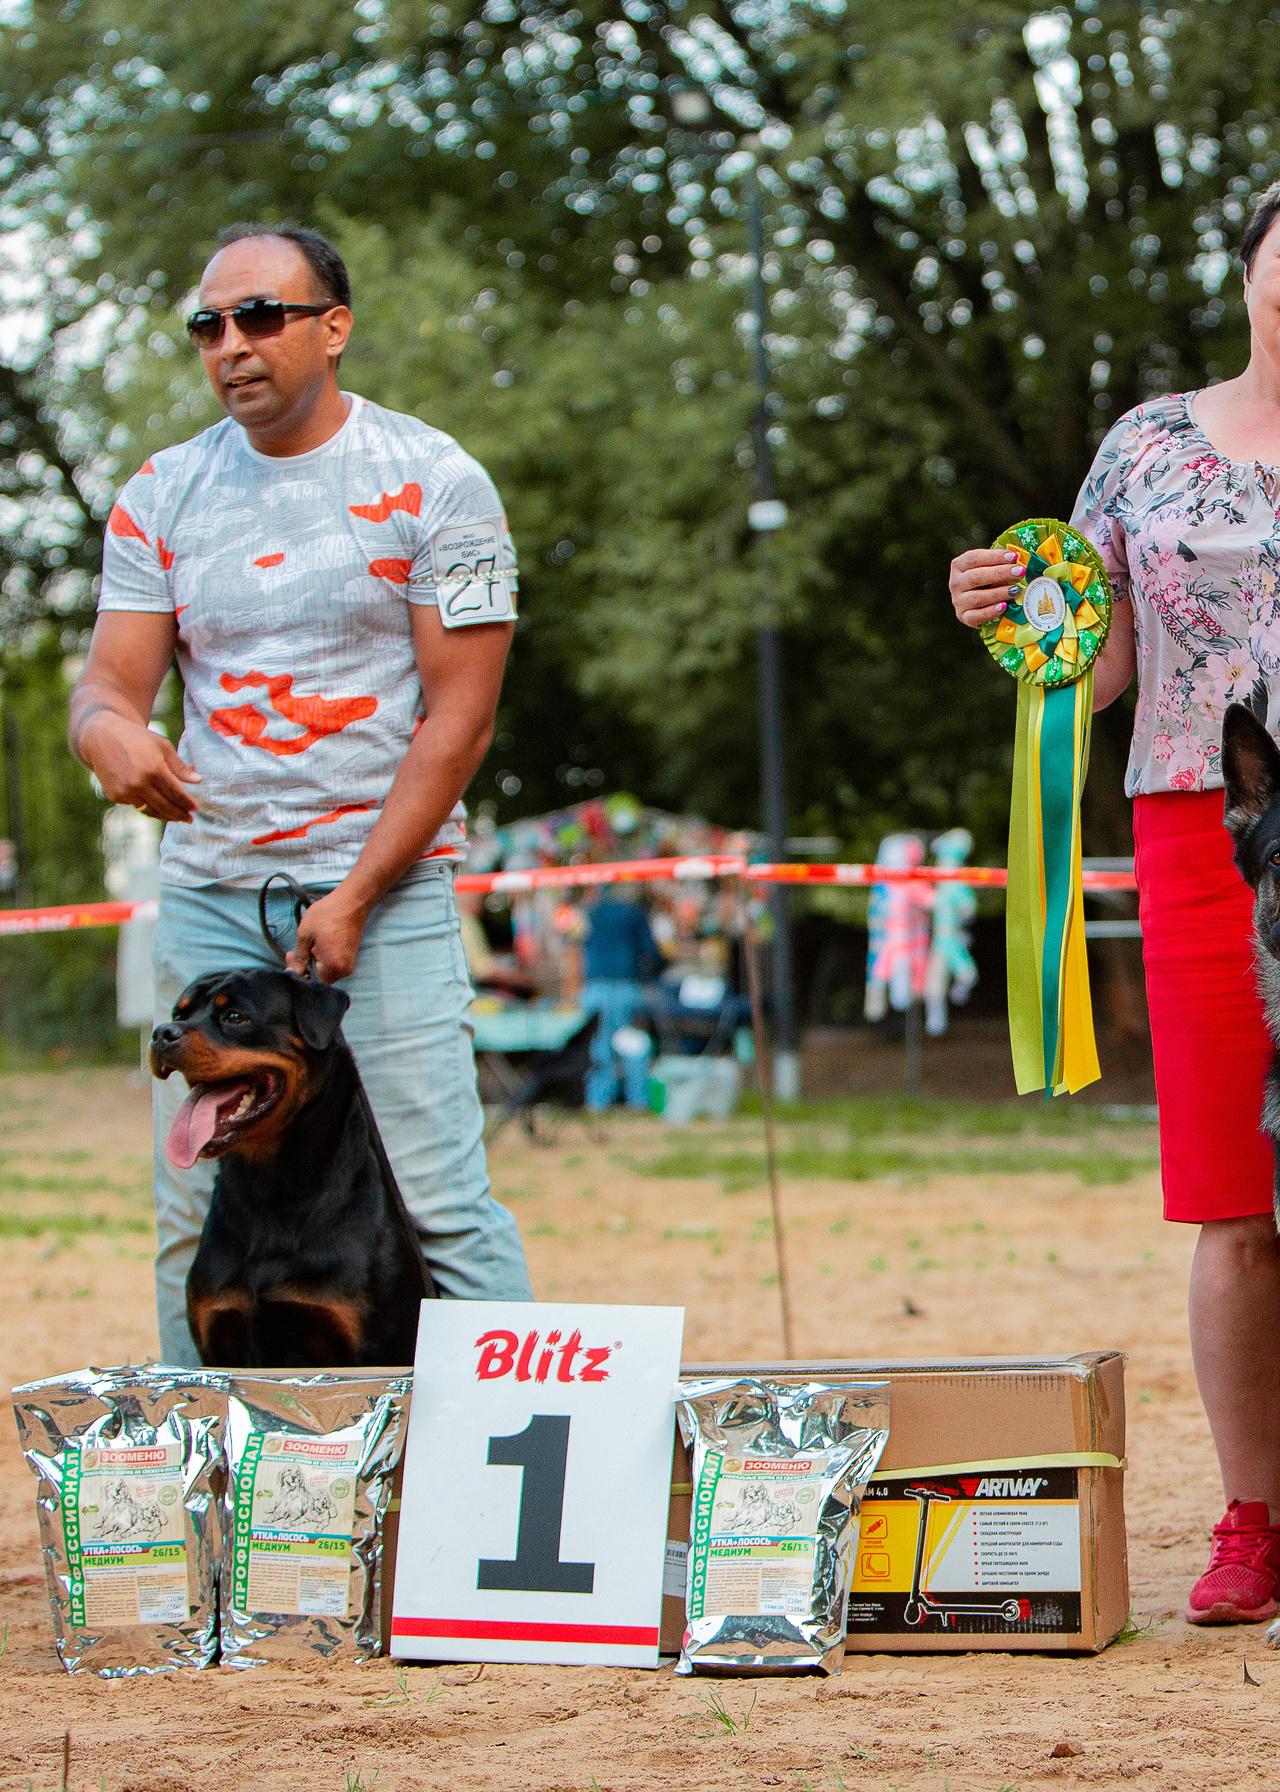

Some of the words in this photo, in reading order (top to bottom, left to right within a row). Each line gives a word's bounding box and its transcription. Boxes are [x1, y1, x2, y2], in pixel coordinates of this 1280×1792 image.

[445, 553, 500, 617] 27
[474, 1328, 613, 1384] Blitz
[285, 1442, 346, 1454] ЗООМЕНЮ
[102, 1450, 165, 1462] ЗООМЕНЮ
[746, 1461, 810, 1470] ЗООМЕНЮ
[876, 1487, 889, 1496] 4.0
[975, 1478, 1042, 1497] ARTWAY
[476, 1414, 595, 1594] 1
[234, 1436, 262, 1608] ПРОФЕССИОНАЛ
[64, 1452, 84, 1624] ПРОФЕССИОНАЛ
[252, 1531, 309, 1542] УТКА+ЛОСОСЬ
[691, 1453, 721, 1615] ПРОФЕССИОНАЛ
[251, 1542, 291, 1551] МЕДИУМ
[317, 1541, 345, 1550] 26/15
[710, 1537, 771, 1547] УТКА+ЛОСОСЬ
[781, 1543, 809, 1551] 26/15
[82, 1545, 143, 1556] УТКА+ЛОСОСЬ
[152, 1548, 180, 1557] 26/15
[710, 1548, 751, 1557] МЕДИУМ
[84, 1556, 124, 1566] МЕДИУМ
